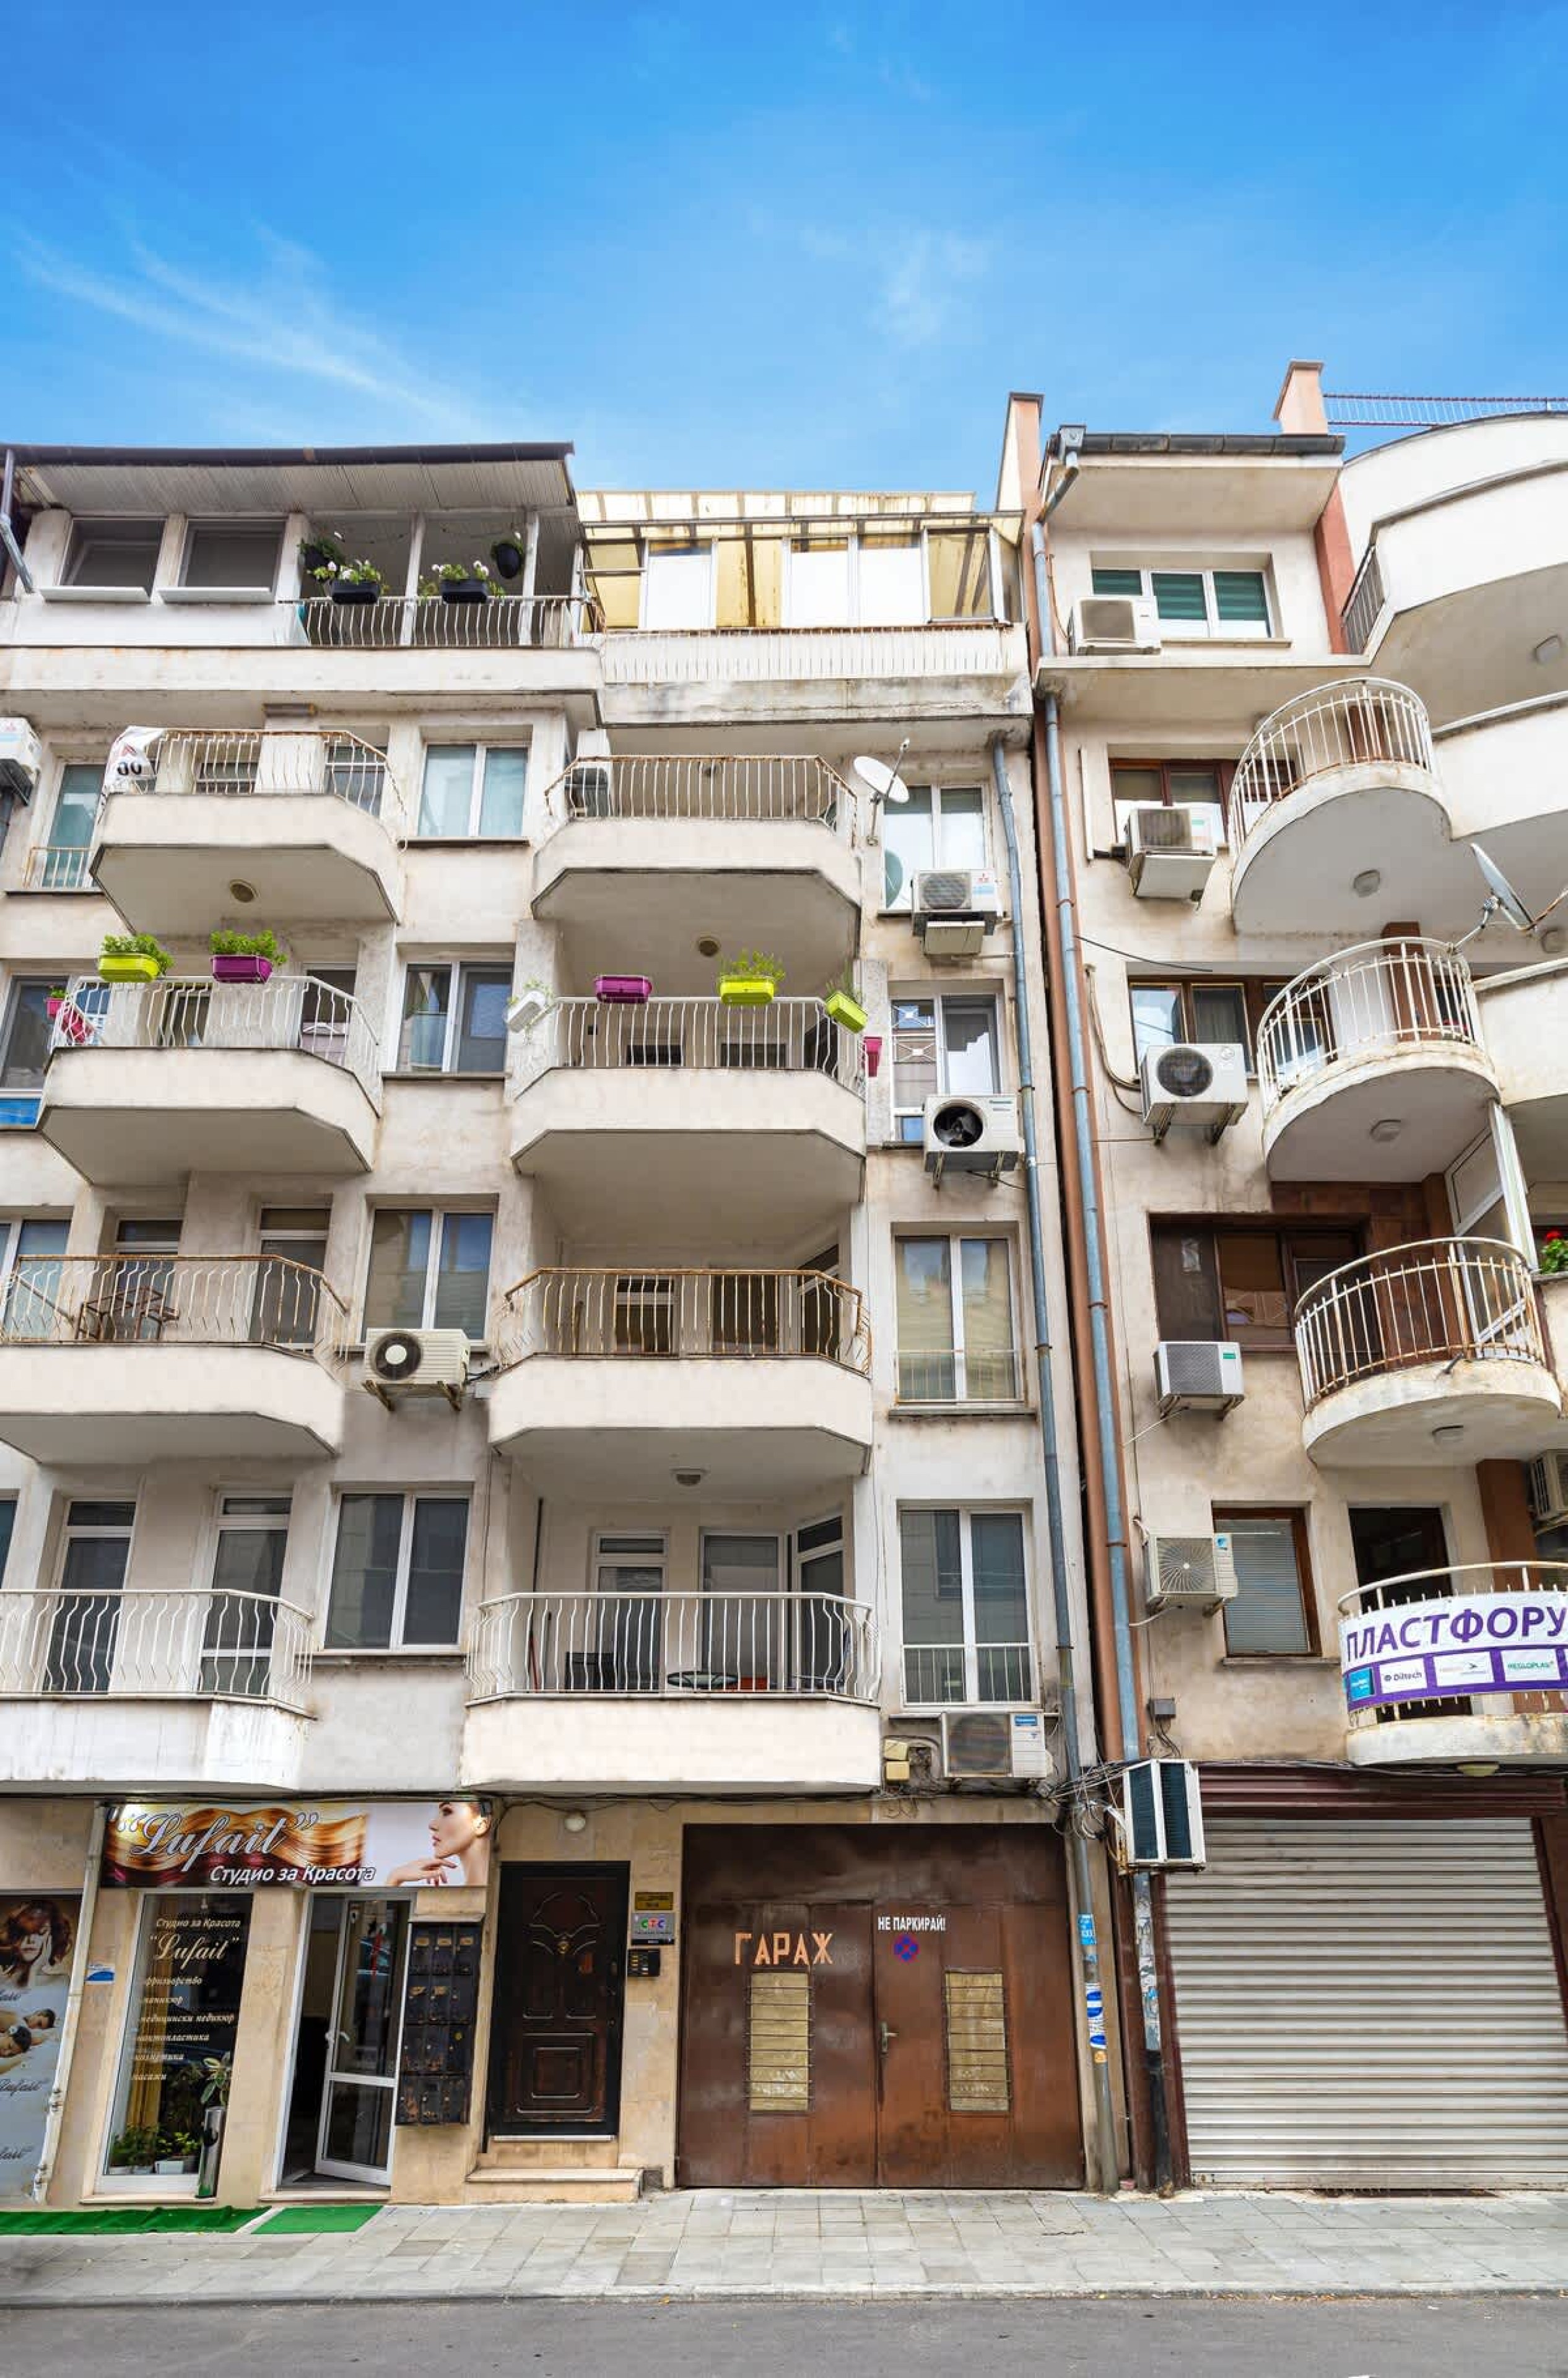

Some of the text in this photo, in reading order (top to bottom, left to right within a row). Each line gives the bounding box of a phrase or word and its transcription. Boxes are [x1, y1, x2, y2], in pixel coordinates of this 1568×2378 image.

[1347, 1607, 1566, 1662] ПЛАСТФОРУ
[210, 1865, 377, 1884] Студио за Красота
[878, 1914, 946, 1931] НЕ ПАРКИРАЙ!
[733, 1933, 834, 1966] ГАРАЖ
